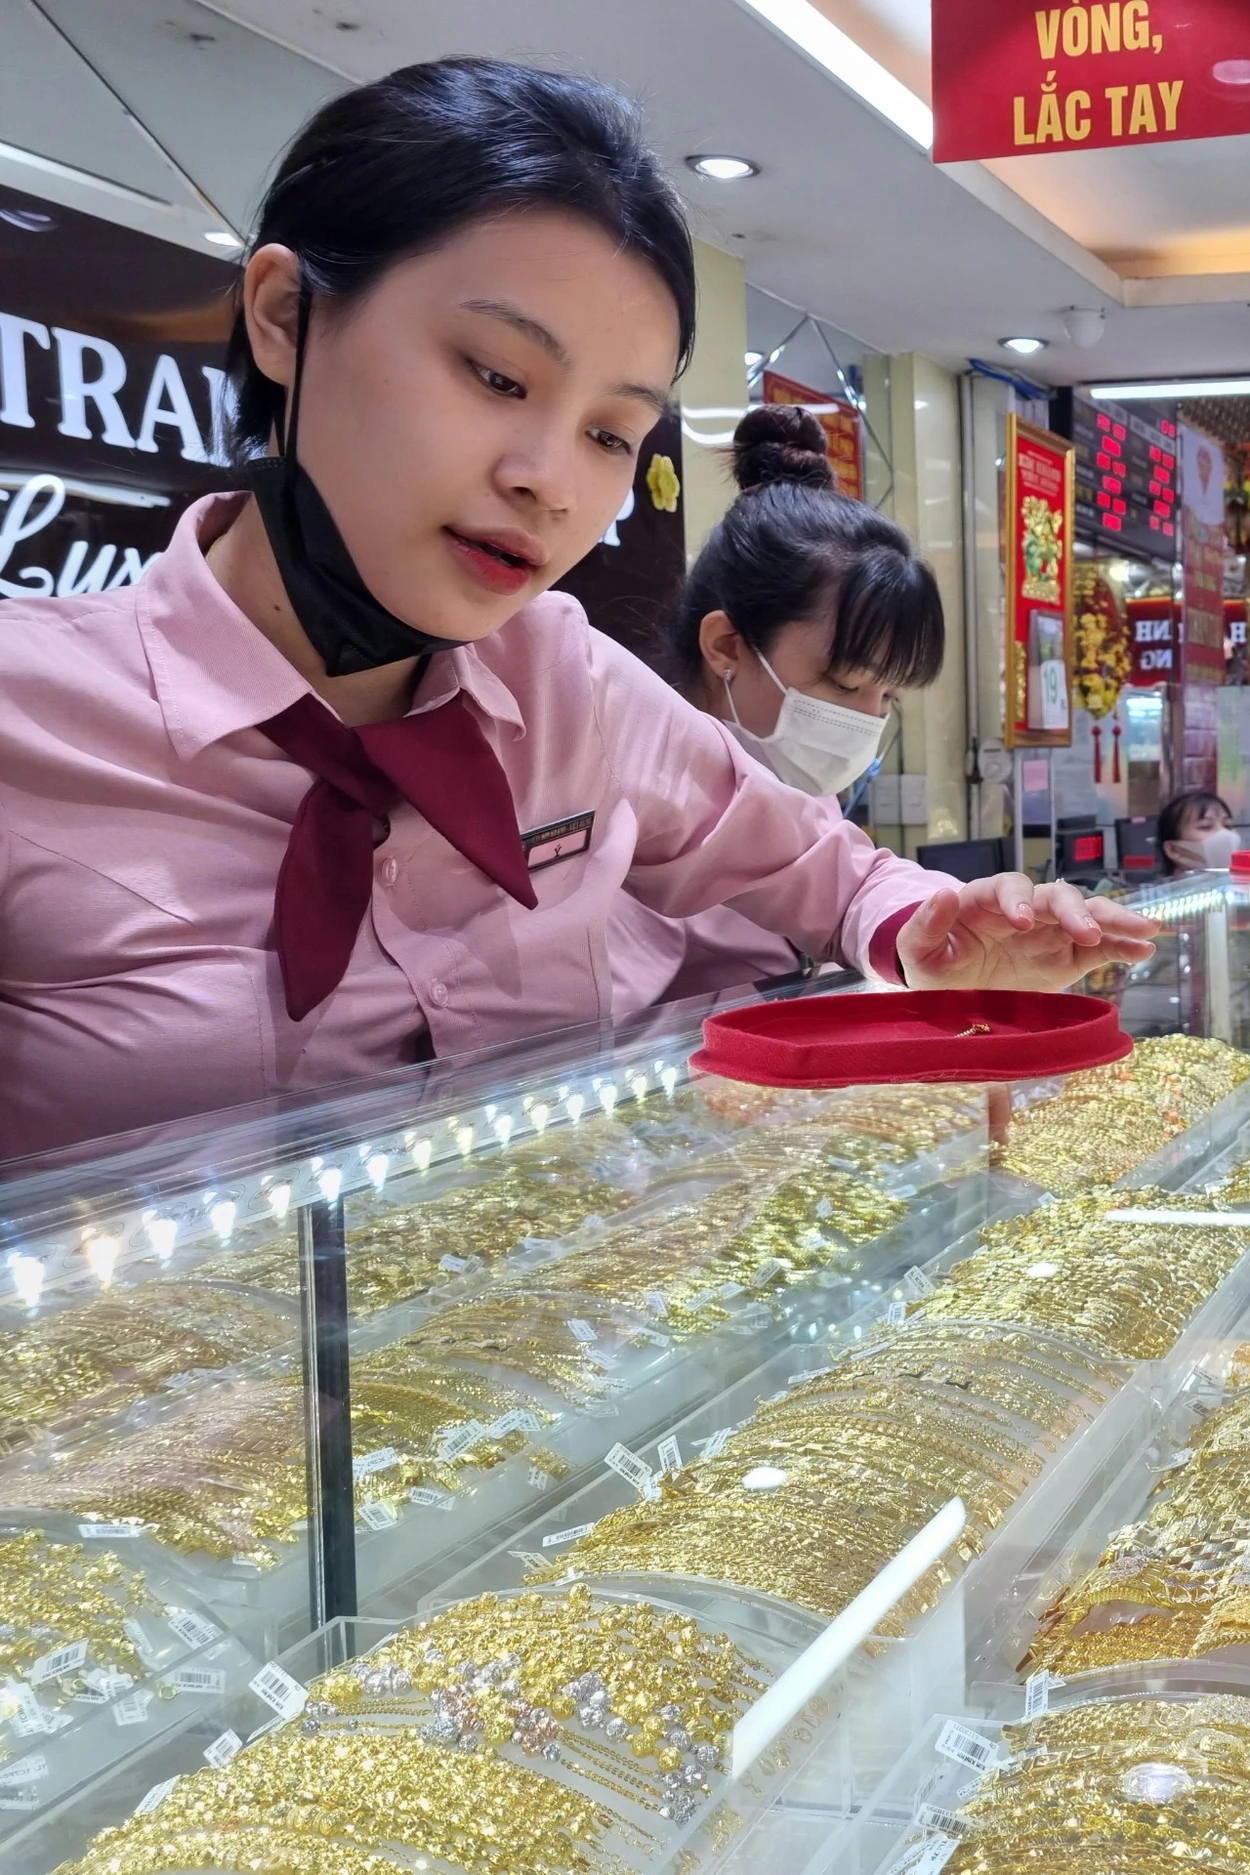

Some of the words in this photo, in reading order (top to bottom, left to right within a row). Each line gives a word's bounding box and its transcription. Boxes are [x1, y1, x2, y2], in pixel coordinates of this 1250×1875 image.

[1034, 0, 1163, 59] VÒNG,
[1014, 70, 1092, 145] LẮC
[1105, 80, 1184, 137] TAY
